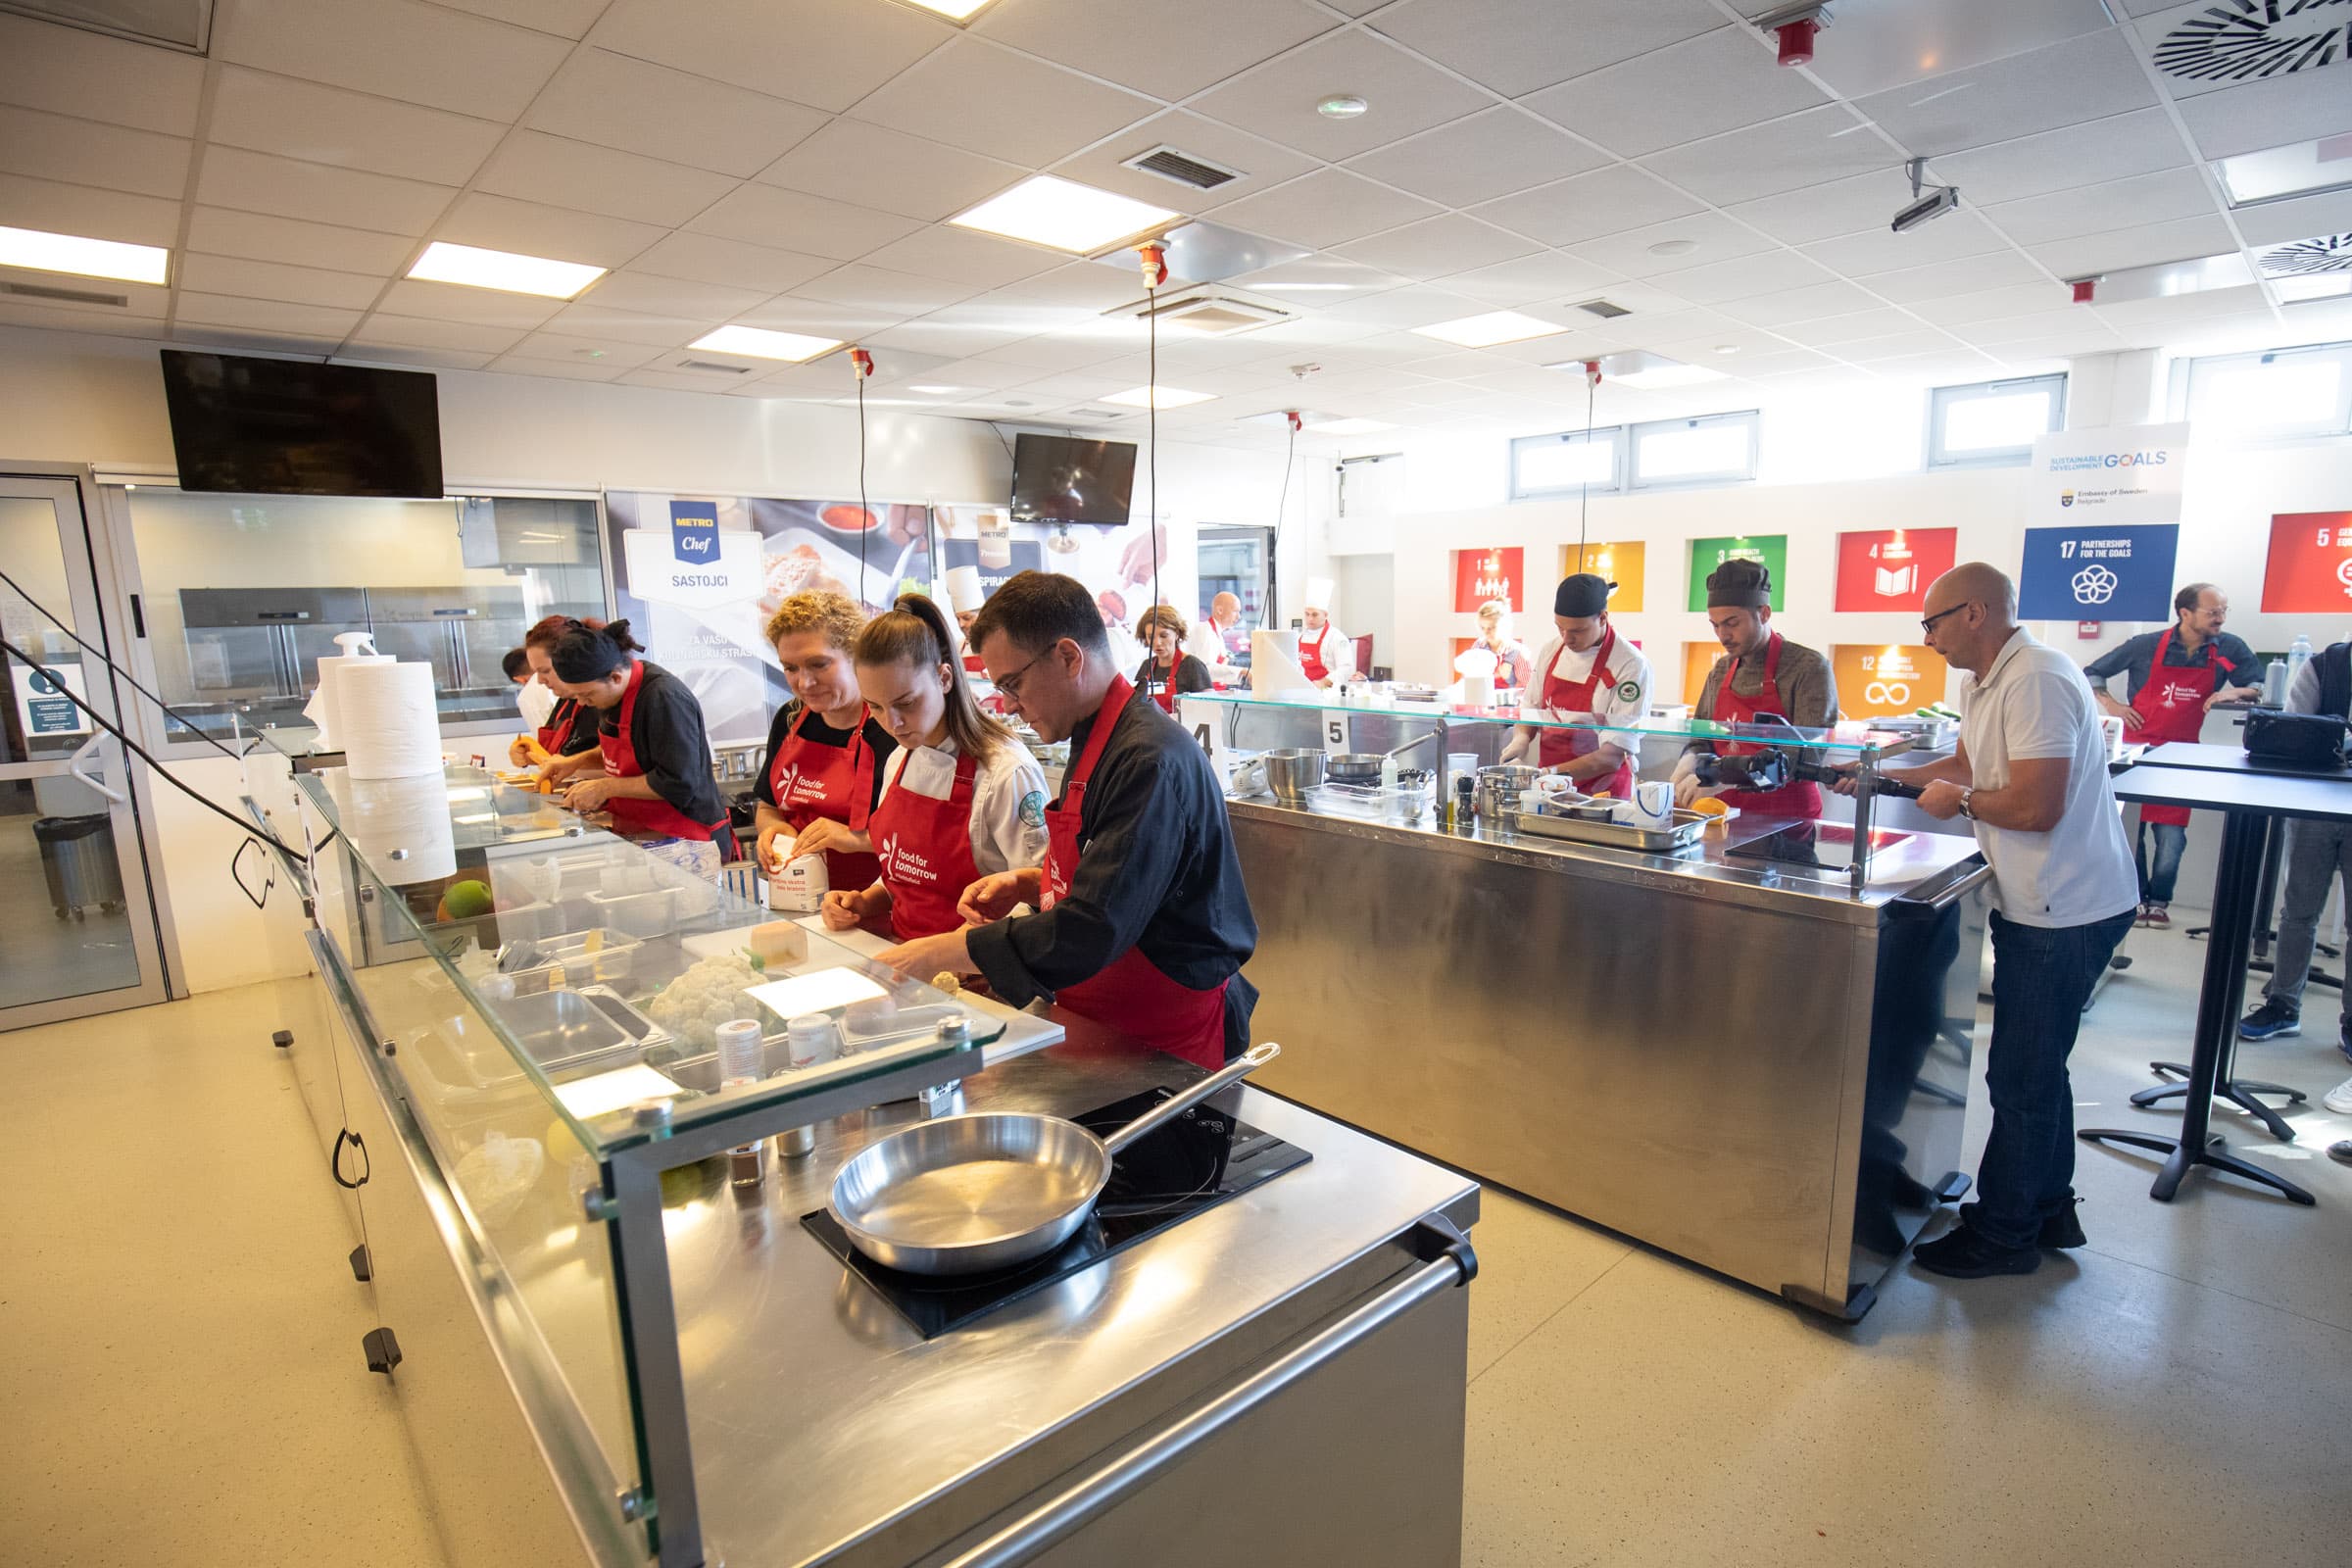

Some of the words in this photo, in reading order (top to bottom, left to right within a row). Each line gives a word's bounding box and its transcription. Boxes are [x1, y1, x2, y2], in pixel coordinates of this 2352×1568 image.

[2051, 455, 2103, 464] SUSTAINABLE
[2104, 451, 2167, 467] GOALS
[2049, 463, 2102, 471] DEVELOPMENT
[675, 517, 714, 527] METRO
[2081, 539, 2132, 549] PARTNERSHIPS
[2316, 527, 2330, 547] 5
[681, 536, 711, 554] Chef
[1868, 543, 1878, 559] 4
[2060, 540, 2077, 559] 17
[1587, 554, 1593, 567] 2
[1717, 549, 1725, 564] 3
[2095, 549, 2107, 558] THE
[2108, 549, 2132, 558] GOALS
[1476, 559, 1482, 571] 1
[671, 575, 728, 587] SASTOJCI
[1861, 656, 1875, 670] 12
[1329, 721, 1343, 743] 5
[1194, 723, 1213, 760] 4
[797, 775, 814, 788] food
[813, 780, 825, 790] for
[793, 785, 827, 800] tomorrow
[898, 848, 915, 862] food
[915, 855, 928, 867] for
[895, 859, 938, 881] tomorrow
